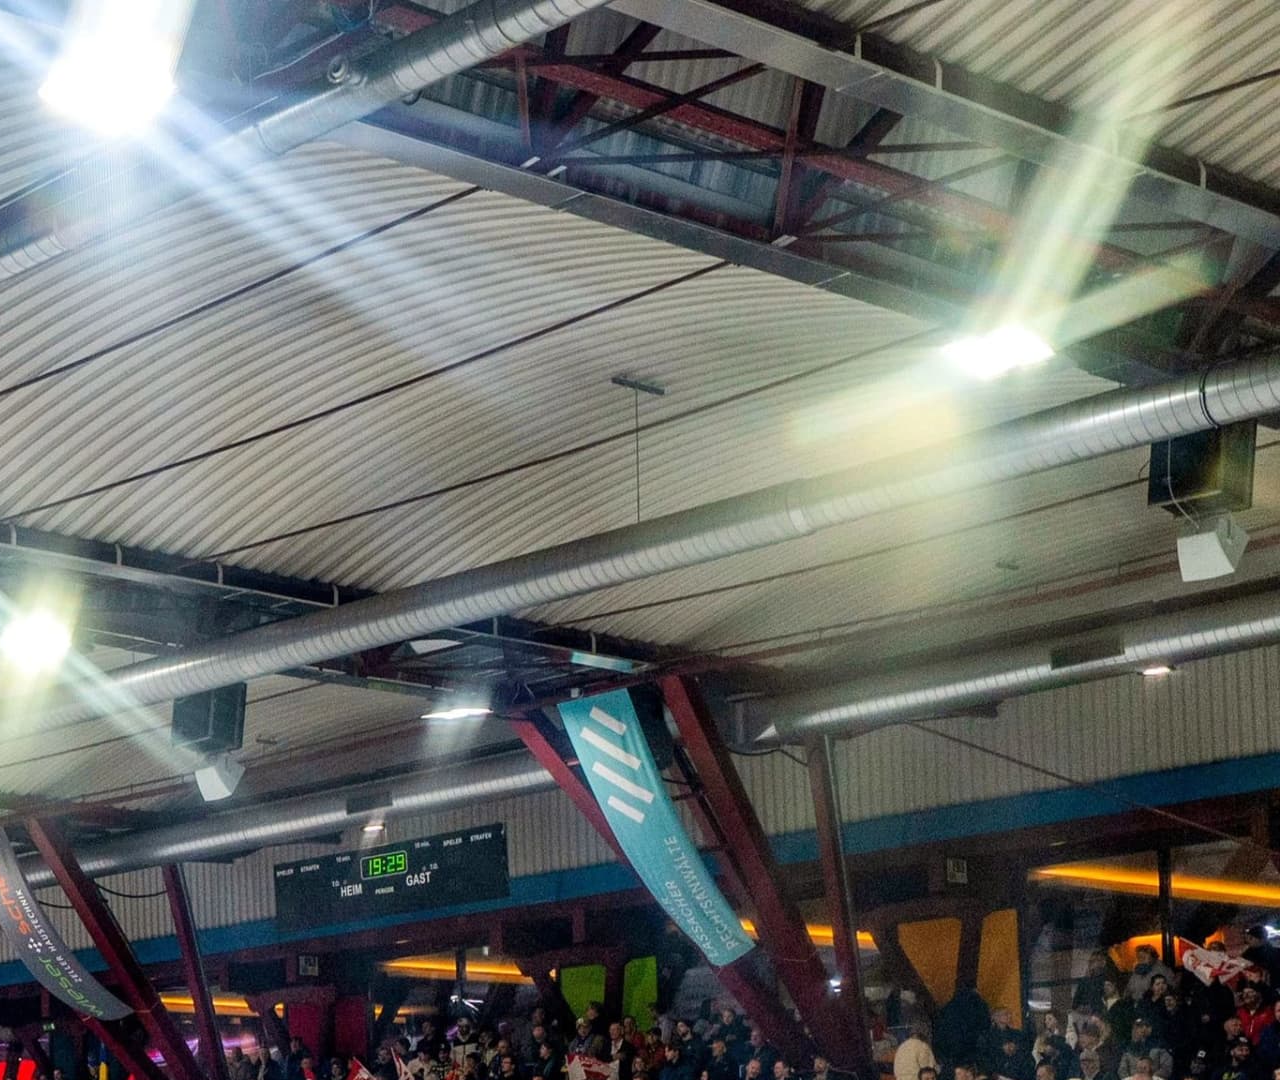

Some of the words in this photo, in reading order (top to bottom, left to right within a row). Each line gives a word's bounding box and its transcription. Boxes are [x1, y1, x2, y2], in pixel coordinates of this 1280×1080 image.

[366, 854, 406, 876] 19:29
[340, 883, 363, 897] HEIM
[406, 871, 431, 886] GAST
[664, 835, 739, 950] RECHTSANWÄLTE
[15, 888, 56, 953] HAUSTECHNIK
[56, 955, 83, 983] ZELLER
